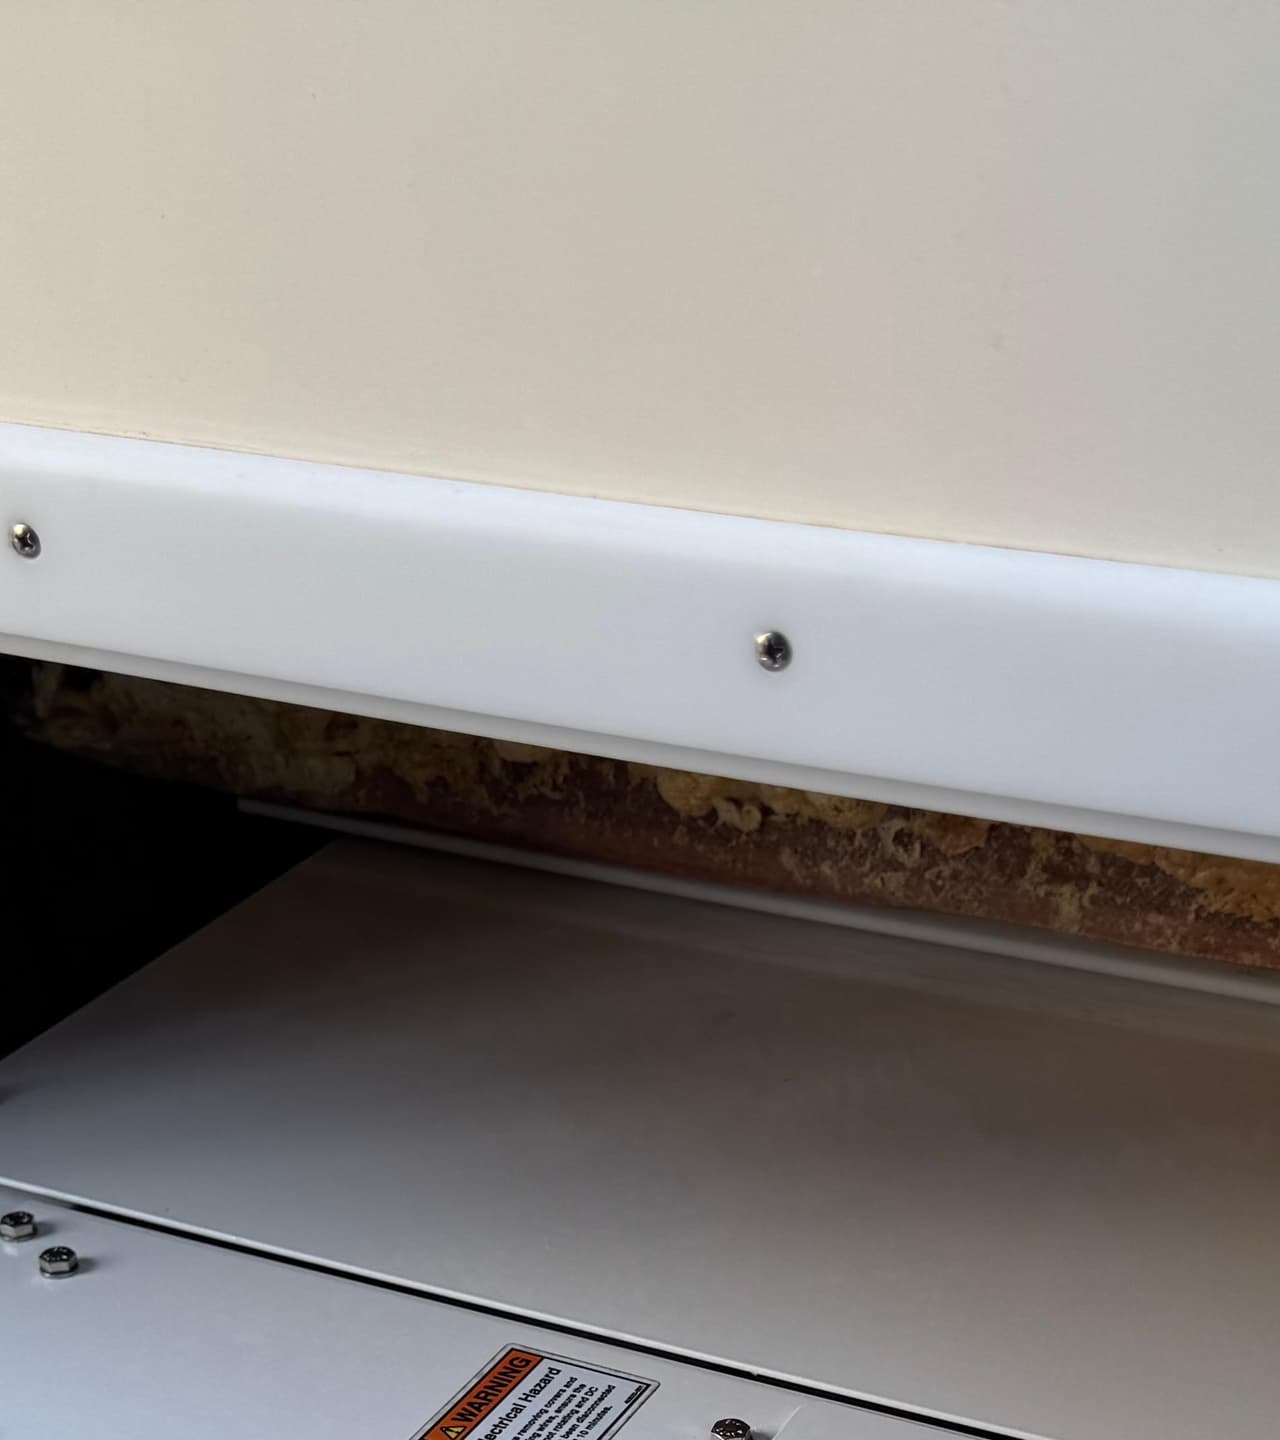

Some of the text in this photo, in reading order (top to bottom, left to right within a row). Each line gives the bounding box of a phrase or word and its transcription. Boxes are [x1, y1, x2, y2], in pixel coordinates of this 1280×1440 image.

[451, 1357, 532, 1423] WARNING
[518, 1367, 562, 1403] Hazard
[554, 1394, 577, 1414] ensure
[572, 1384, 587, 1393] the
[517, 1408, 549, 1436] removing
[544, 1389, 567, 1408] covers
[563, 1377, 578, 1389] and
[553, 1409, 580, 1432] rotating
[575, 1396, 590, 1409] and
[584, 1387, 598, 1397] DC
[560, 1424, 580, 1439] been
[577, 1430, 589, 1438] 10
